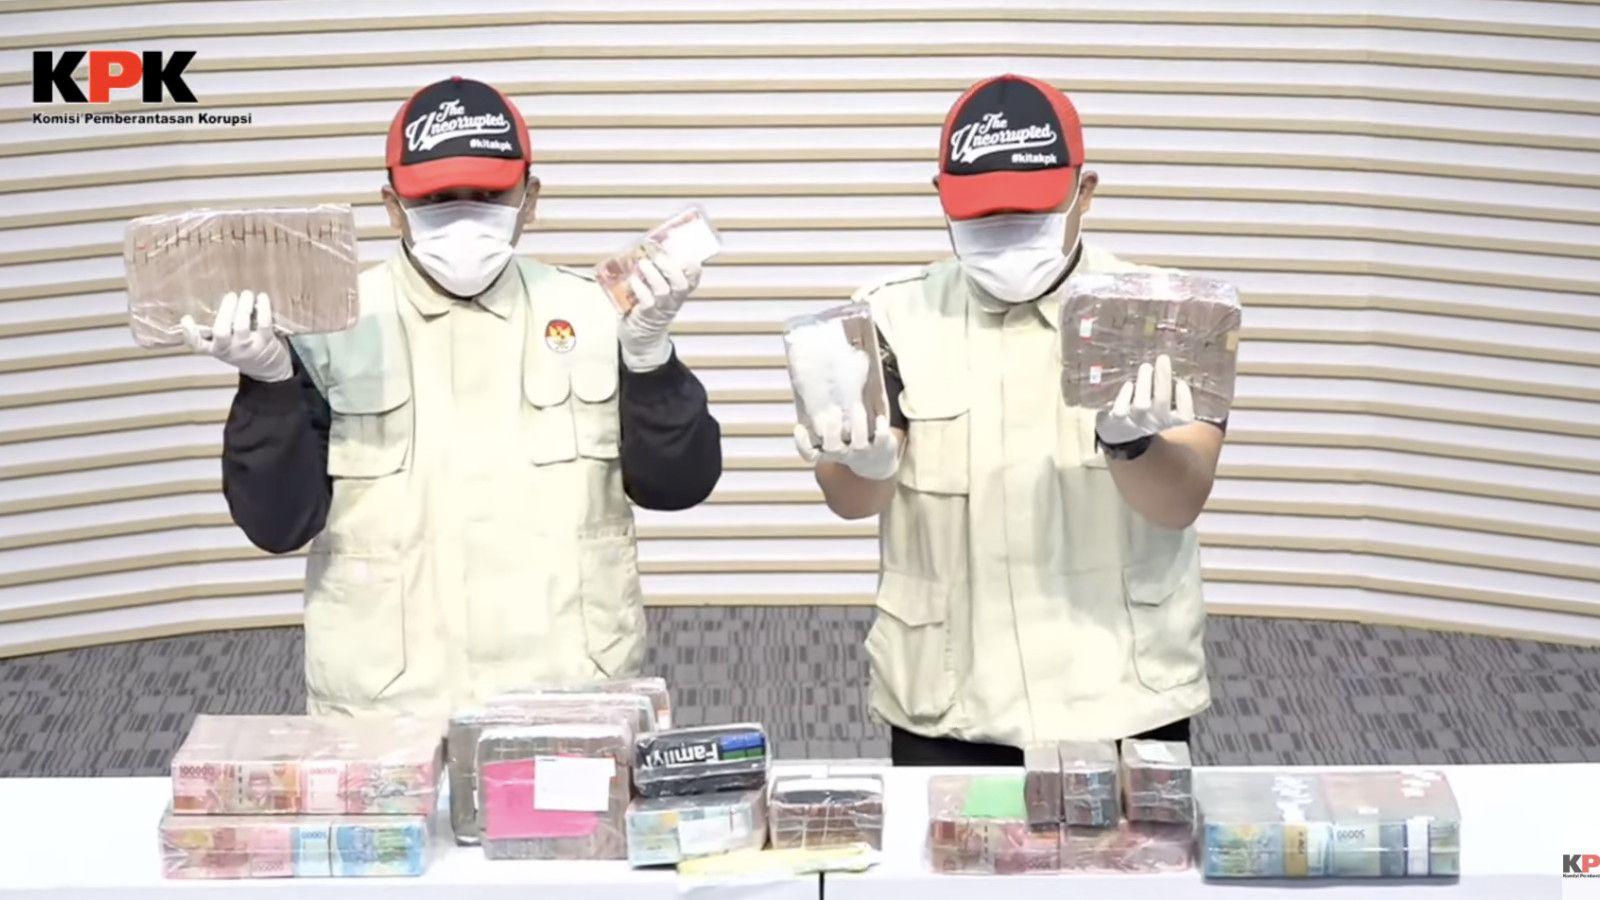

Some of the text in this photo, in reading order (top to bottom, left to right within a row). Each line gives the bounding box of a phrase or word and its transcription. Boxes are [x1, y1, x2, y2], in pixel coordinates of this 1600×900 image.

[436, 98, 465, 122] The
[405, 111, 510, 151] Uncorrupted
[979, 112, 1007, 134] The
[951, 122, 1057, 163] Uncorrupted
[1011, 152, 1057, 165] #kitakpk
